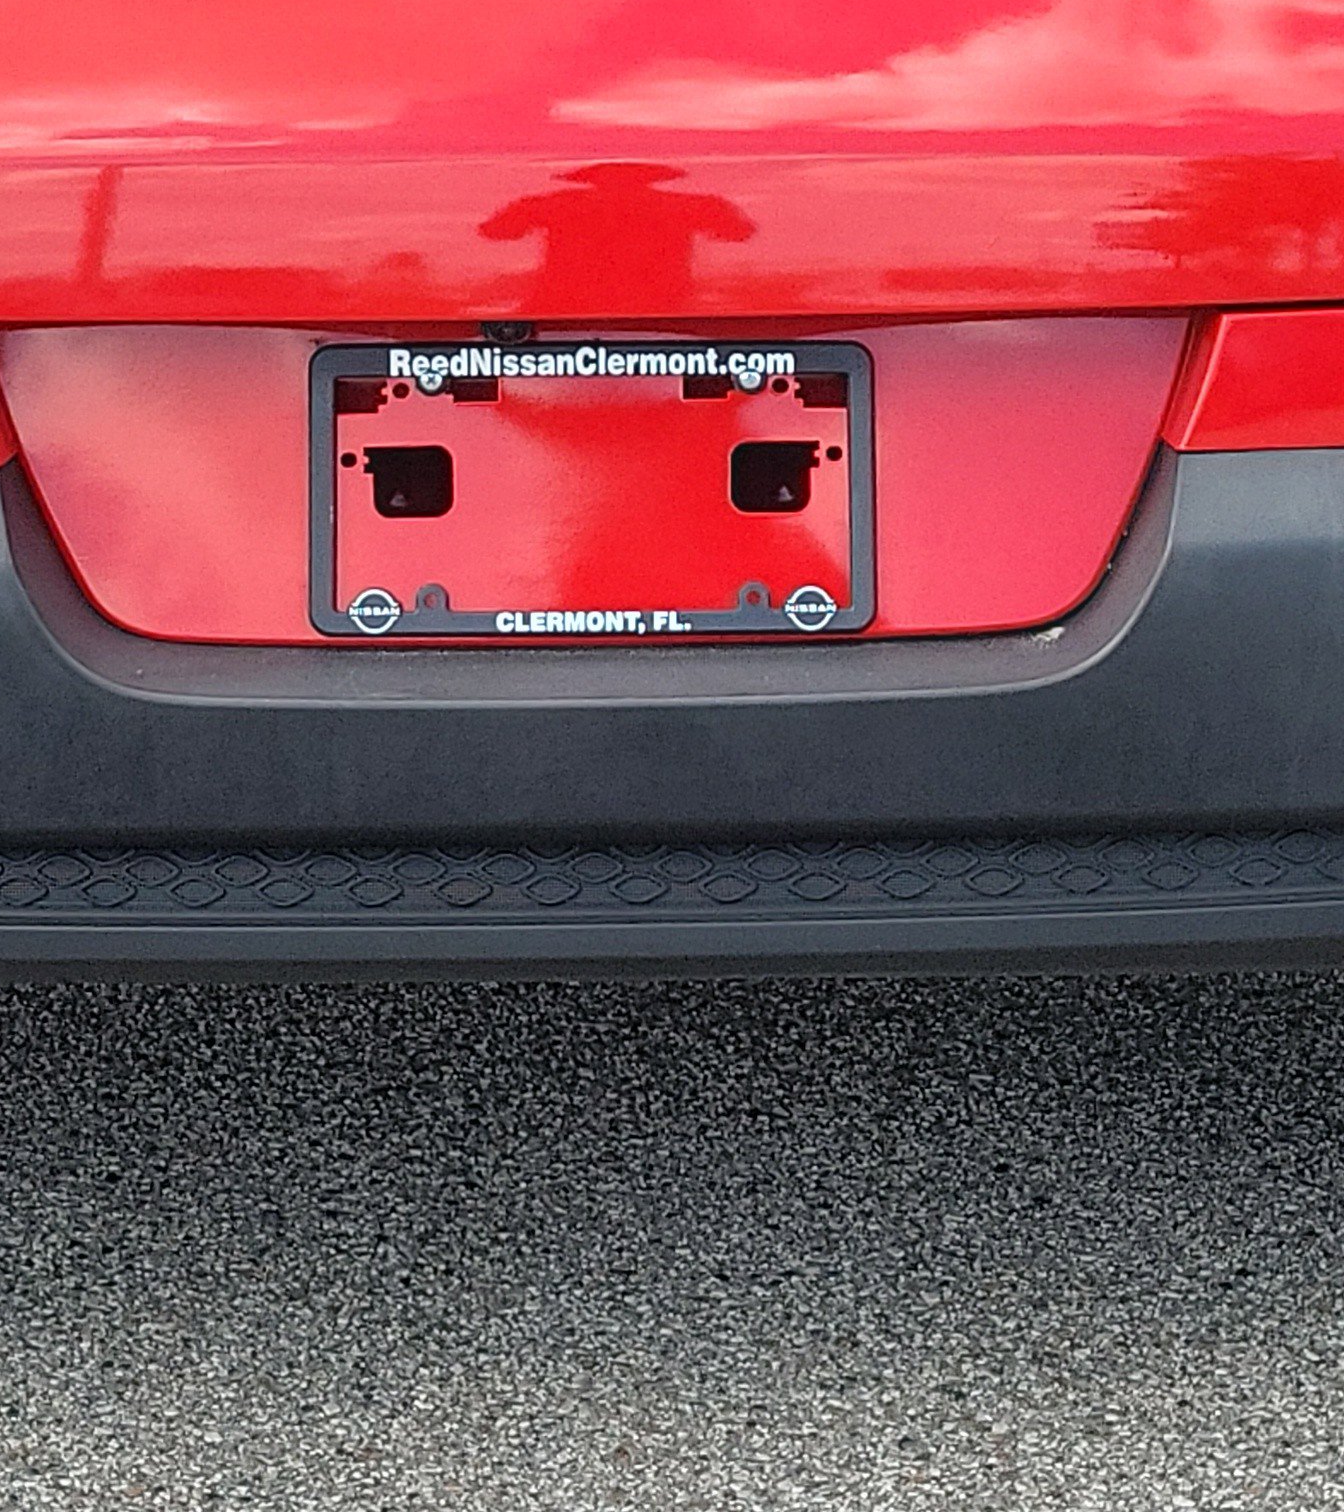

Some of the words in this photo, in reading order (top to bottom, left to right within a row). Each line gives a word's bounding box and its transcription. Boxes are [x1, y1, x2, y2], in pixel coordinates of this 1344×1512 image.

[389, 347, 796, 376] ReedNissanClermont.com
[495, 611, 646, 634] CLERMONT,
[653, 611, 692, 631] FL.
